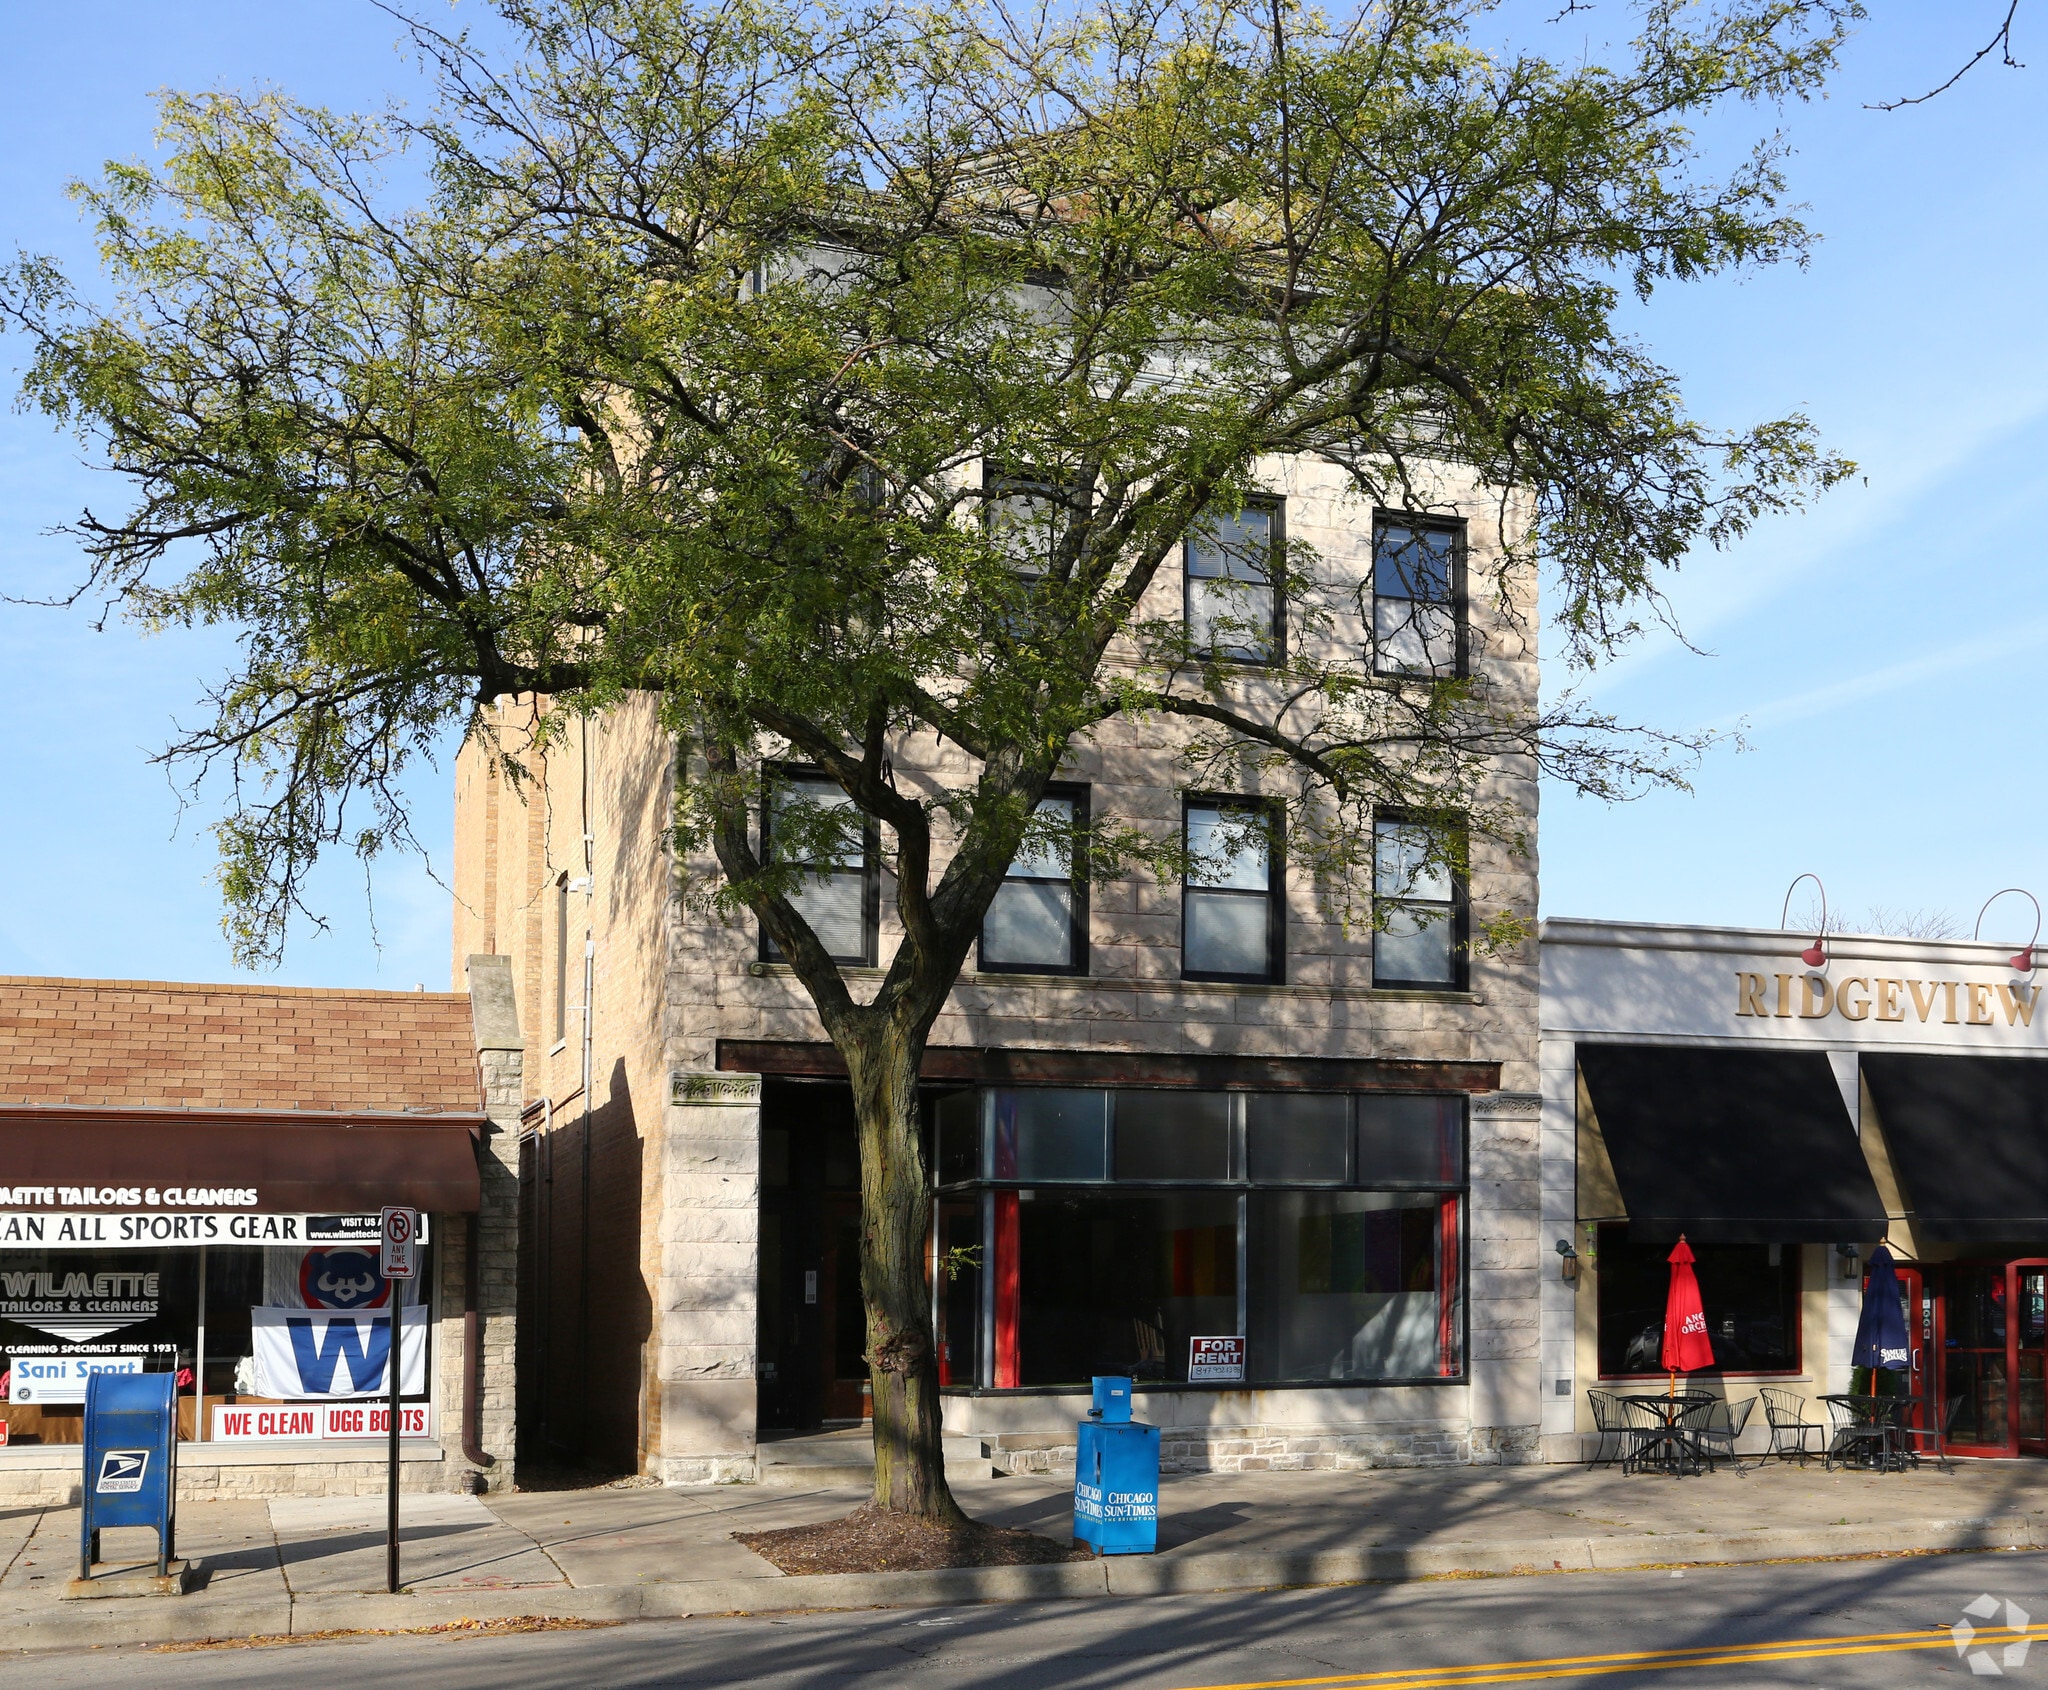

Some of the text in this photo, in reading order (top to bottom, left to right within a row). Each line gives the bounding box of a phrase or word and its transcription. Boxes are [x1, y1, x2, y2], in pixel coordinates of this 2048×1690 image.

[1735, 972, 2042, 1027] RIDGEVIEW
[58, 1187, 141, 1206] TAILORS
[145, 1187, 160, 1206] &
[163, 1188, 258, 1206] CLEANERS
[0, 1216, 298, 1241] AN ALL SPORTS GEAR
[341, 1218, 362, 1227] VISIT
[364, 1218, 376, 1227] US
[391, 1245, 405, 1254] ANY
[391, 1255, 406, 1264] TIME
[1, 1271, 160, 1299] WILMETTE
[0, 1301, 159, 1313] TAILORS & CLEANERS
[5, 1345, 59, 1354] CLEANING
[61, 1344, 118, 1353] SPECIALIST
[120, 1344, 149, 1353] SINCE
[153, 1344, 177, 1352] 1931
[1200, 1340, 1236, 1352] FOR
[286, 1317, 391, 1393] W
[1194, 1352, 1241, 1364] RENT
[18, 1361, 66, 1378] Sani
[224, 1412, 314, 1435] WE CLEAN
[330, 1410, 363, 1432] UGG
[1077, 1481, 1102, 1502] CHICAGO
[1108, 1492, 1153, 1504] CHICAGO
[1074, 1496, 1103, 1519] SUN-TIMES
[1104, 1504, 1156, 1517] SUN-TIMES
